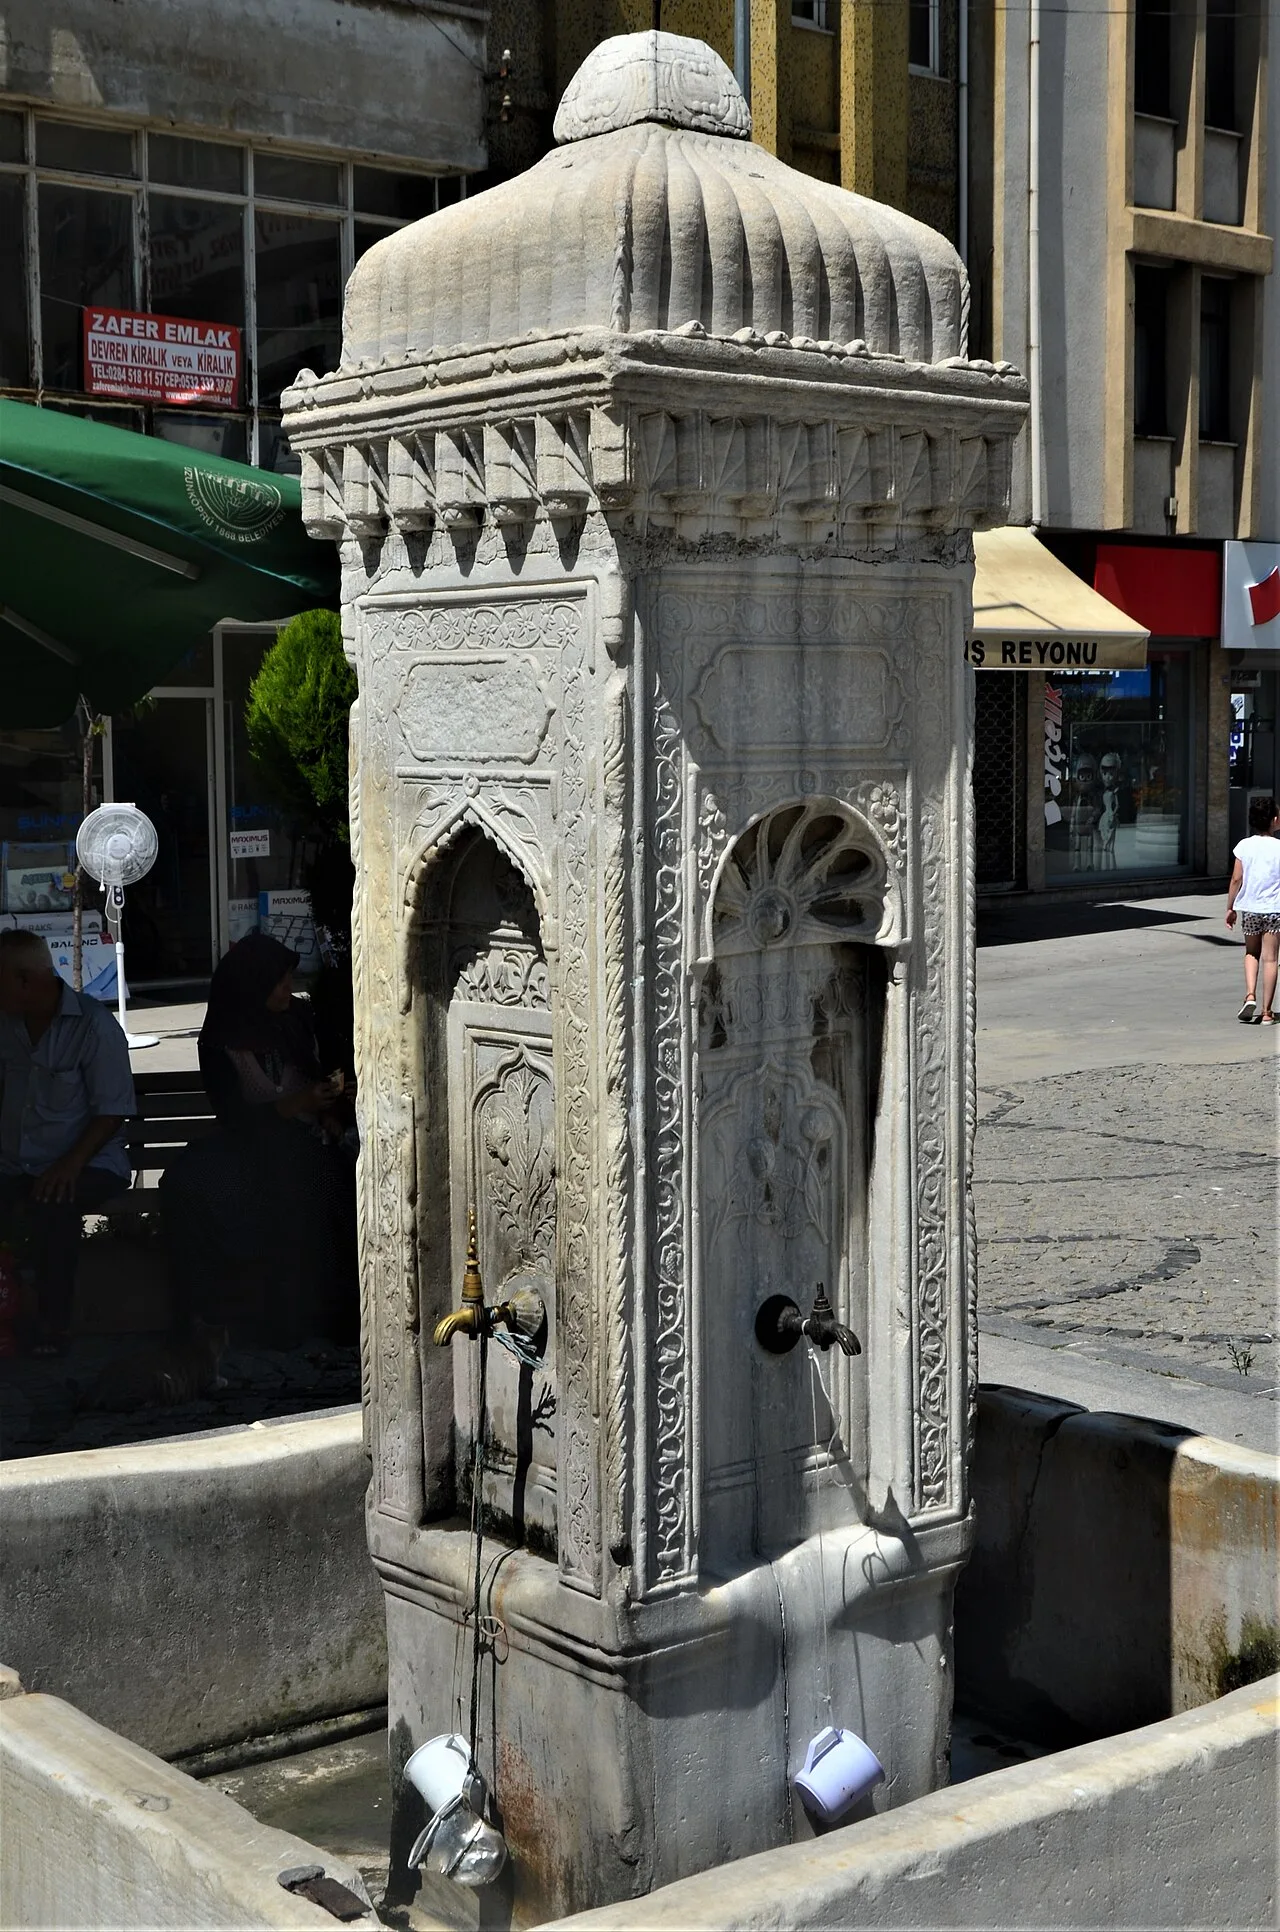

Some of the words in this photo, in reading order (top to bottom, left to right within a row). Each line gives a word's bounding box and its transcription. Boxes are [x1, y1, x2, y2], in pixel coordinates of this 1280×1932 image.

[92, 313, 159, 340] ZAFER
[165, 322, 232, 349] EMLAK
[91, 338, 128, 362] DEVREN
[131, 340, 168, 368] KİRALIK
[172, 355, 193, 369] VEYA
[197, 349, 233, 375] KİRALIK
[91, 363, 127, 382] TEL:0284
[128, 368, 142, 384] 518
[144, 370, 153, 385] 11
[154, 371, 164, 386] 57
[1001, 640, 1098, 665] REYONU
[231, 834, 269, 844] MAXIMUS
